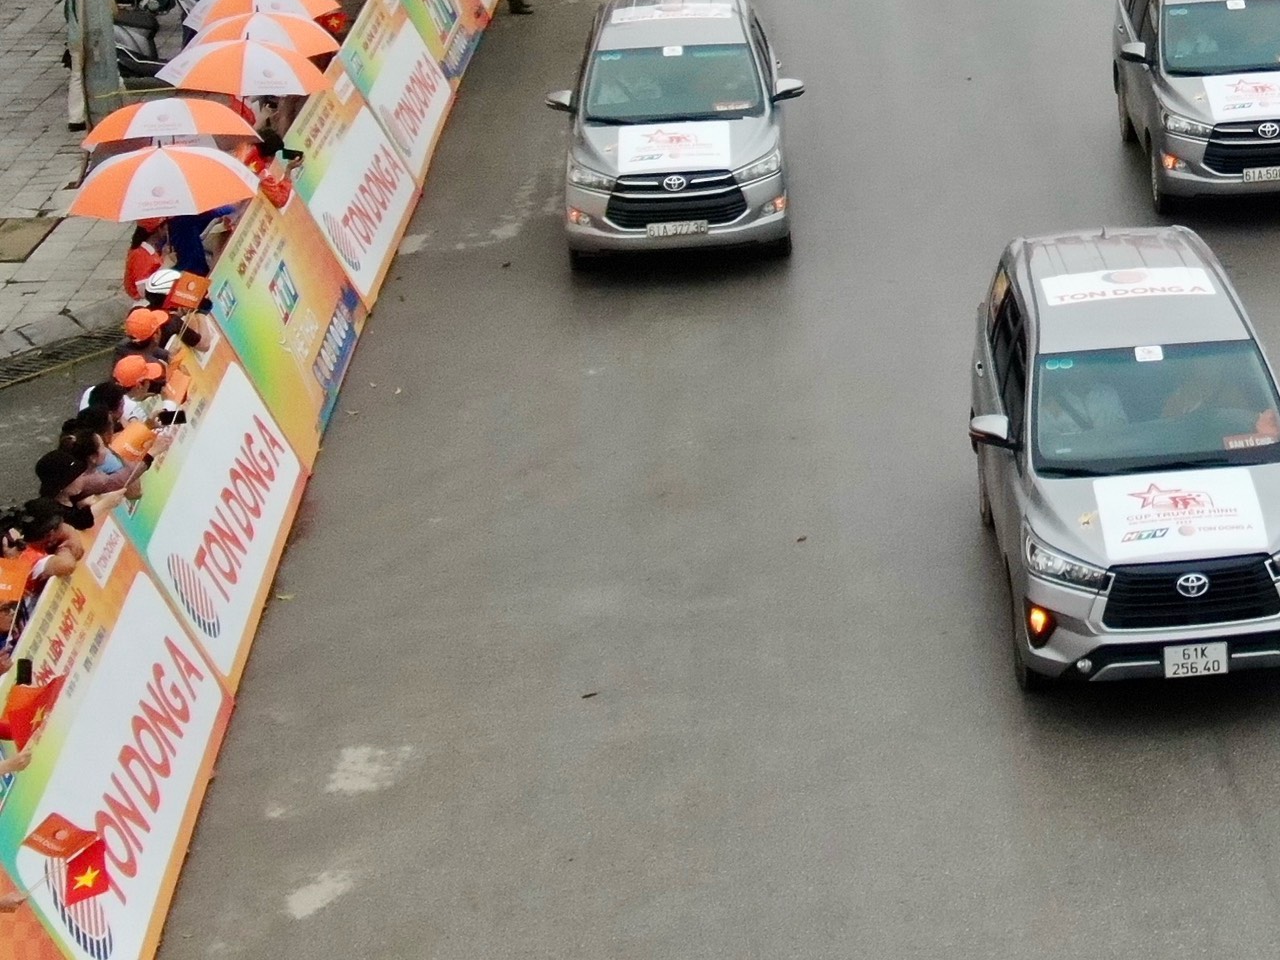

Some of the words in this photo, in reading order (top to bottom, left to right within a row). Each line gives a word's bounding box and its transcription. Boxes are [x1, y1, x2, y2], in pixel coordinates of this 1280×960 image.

[380, 143, 404, 182] A
[358, 153, 397, 224] DONG
[342, 193, 378, 254] TON
[1056, 288, 1108, 303] TON
[1111, 285, 1185, 300] DONG
[1188, 284, 1207, 294] A
[194, 506, 243, 603] TON
[220, 433, 275, 551] DONG
[253, 414, 285, 455] A
[1122, 528, 1169, 542] HTV
[1172, 659, 1221, 676] 256.40
[1182, 647, 1208, 662] 61K
[118, 662, 191, 814] DONG
[164, 635, 204, 700] A
